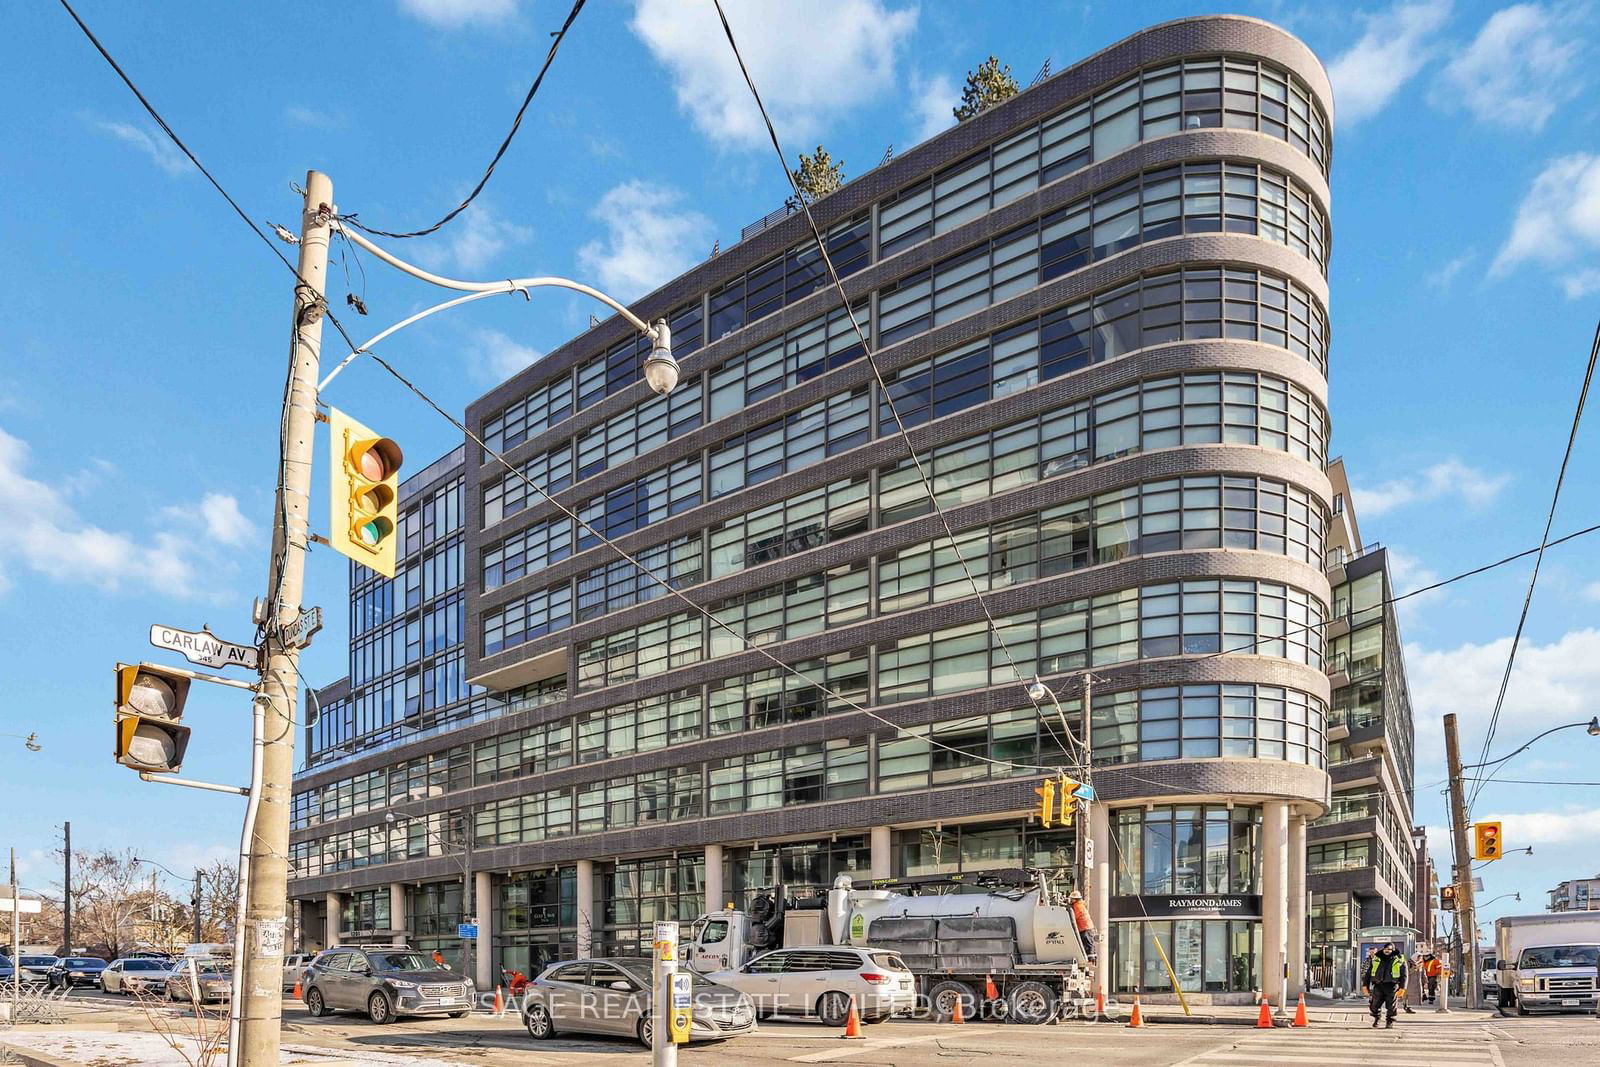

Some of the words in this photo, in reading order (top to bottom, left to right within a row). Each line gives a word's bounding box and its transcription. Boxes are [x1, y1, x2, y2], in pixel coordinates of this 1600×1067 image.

[162, 630, 223, 657] CARLAW
[1169, 899, 1215, 907] RAYMOND
[1216, 899, 1242, 907] JAMES
